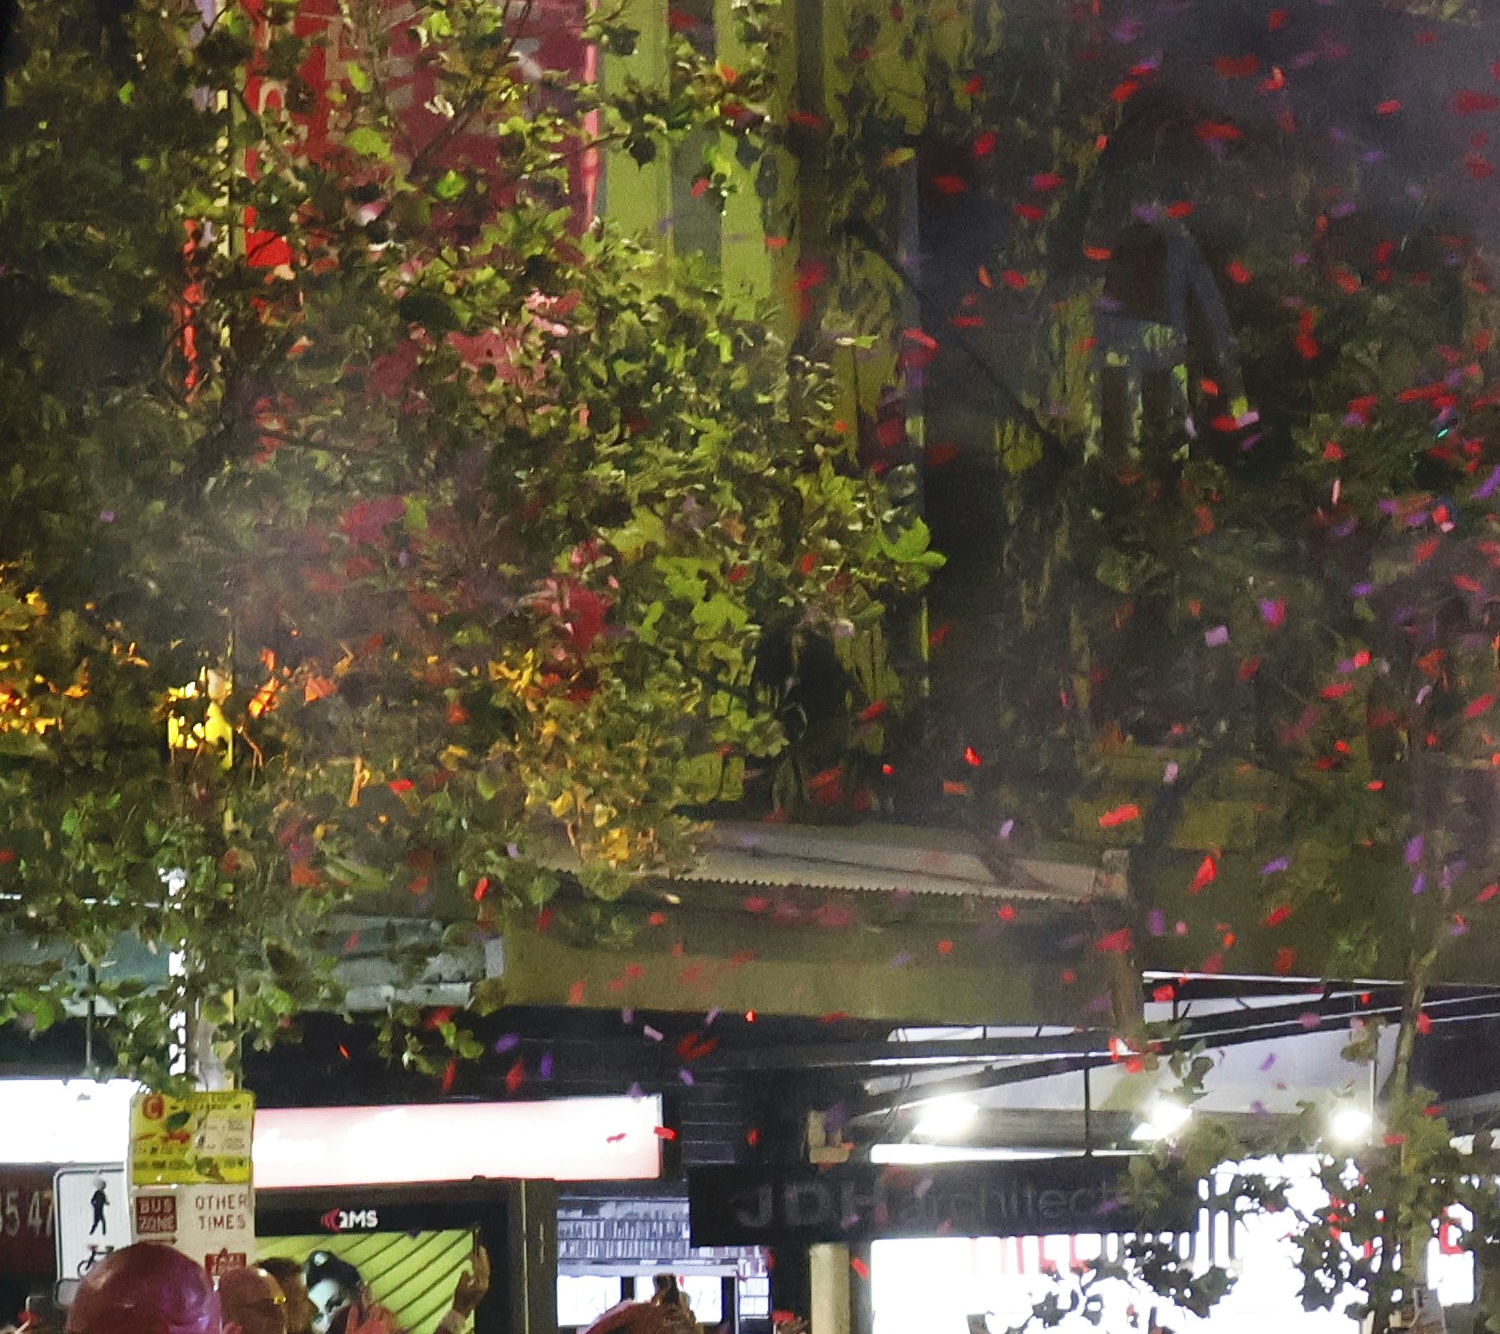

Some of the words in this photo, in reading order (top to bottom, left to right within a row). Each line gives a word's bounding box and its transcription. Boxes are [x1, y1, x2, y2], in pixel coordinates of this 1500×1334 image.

[140, 1198, 174, 1215] BUS
[195, 1194, 248, 1211] OTHER
[731, 1181, 887, 1229] JDH
[198, 1215, 246, 1230] TIMES
